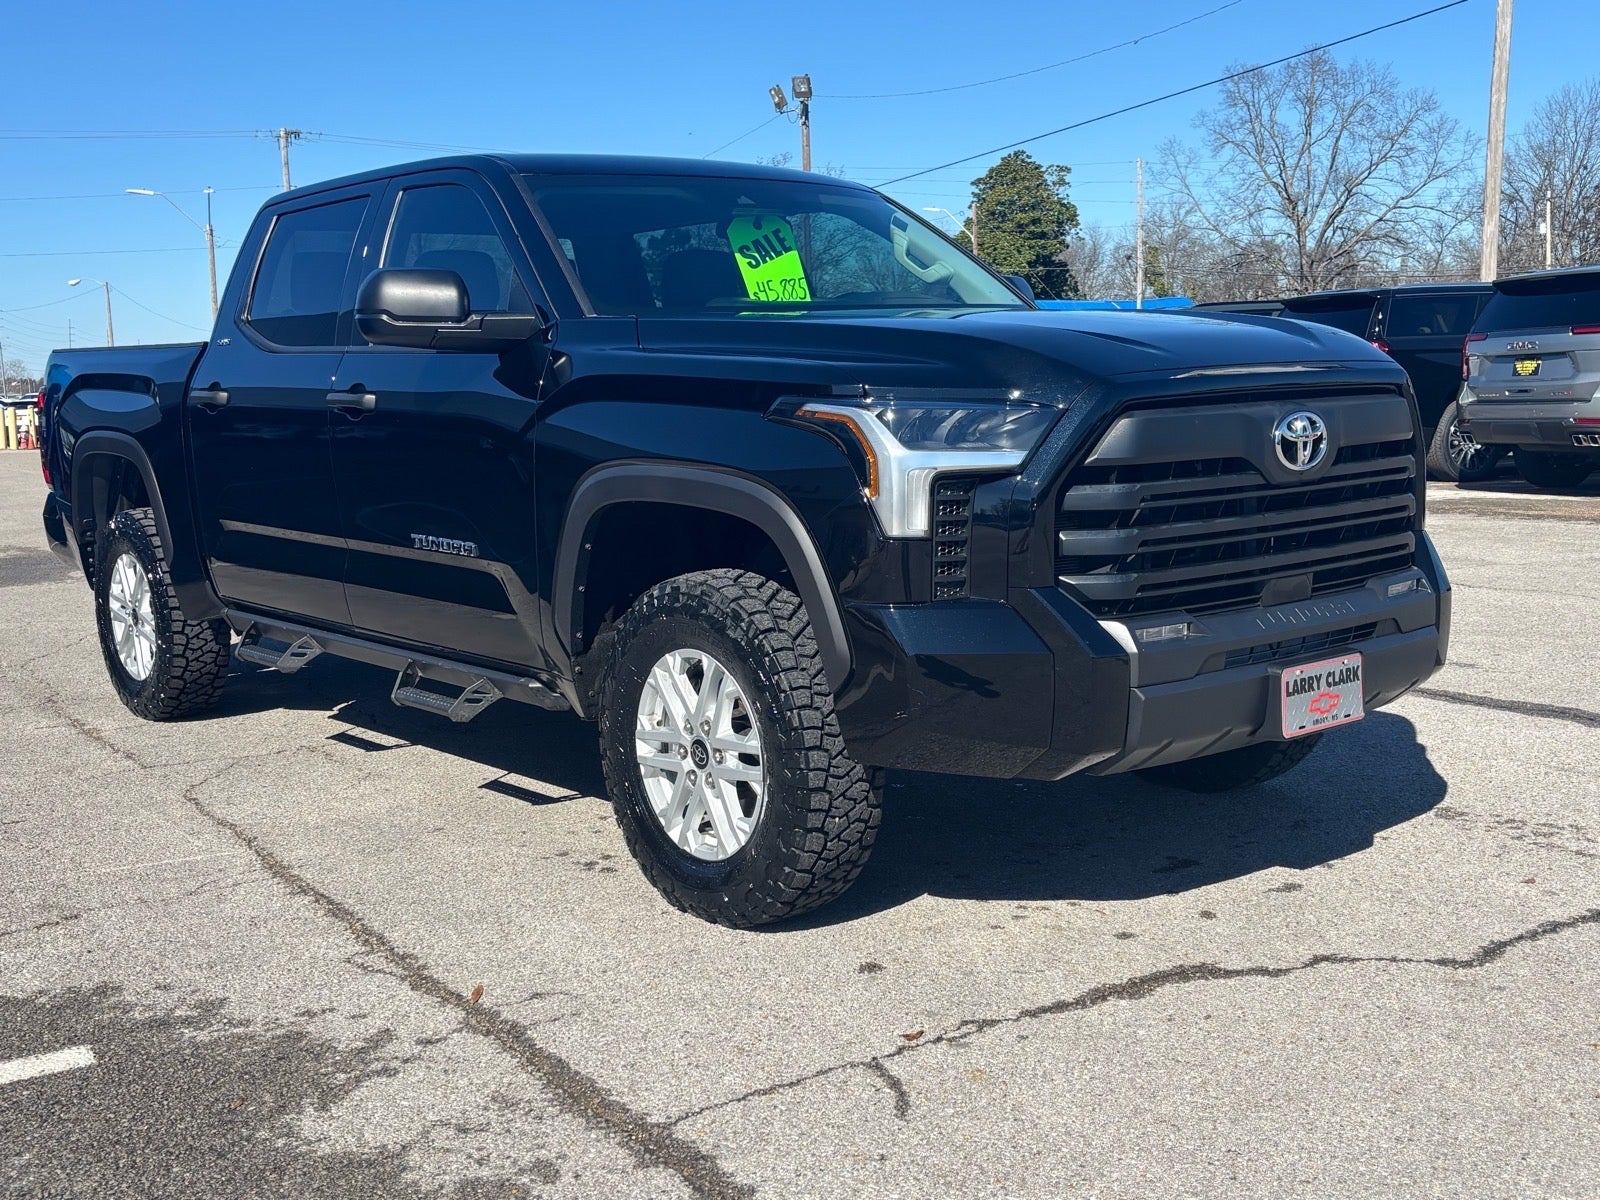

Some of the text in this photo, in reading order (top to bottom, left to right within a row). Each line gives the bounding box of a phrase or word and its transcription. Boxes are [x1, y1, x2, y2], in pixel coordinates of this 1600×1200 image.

[737, 228, 793, 269] SALE
[753, 277, 807, 301] $45,885
[1507, 341, 1540, 351] GMC
[410, 533, 479, 557] TUNDRA
[1286, 665, 1360, 697] LARRY CLARK
